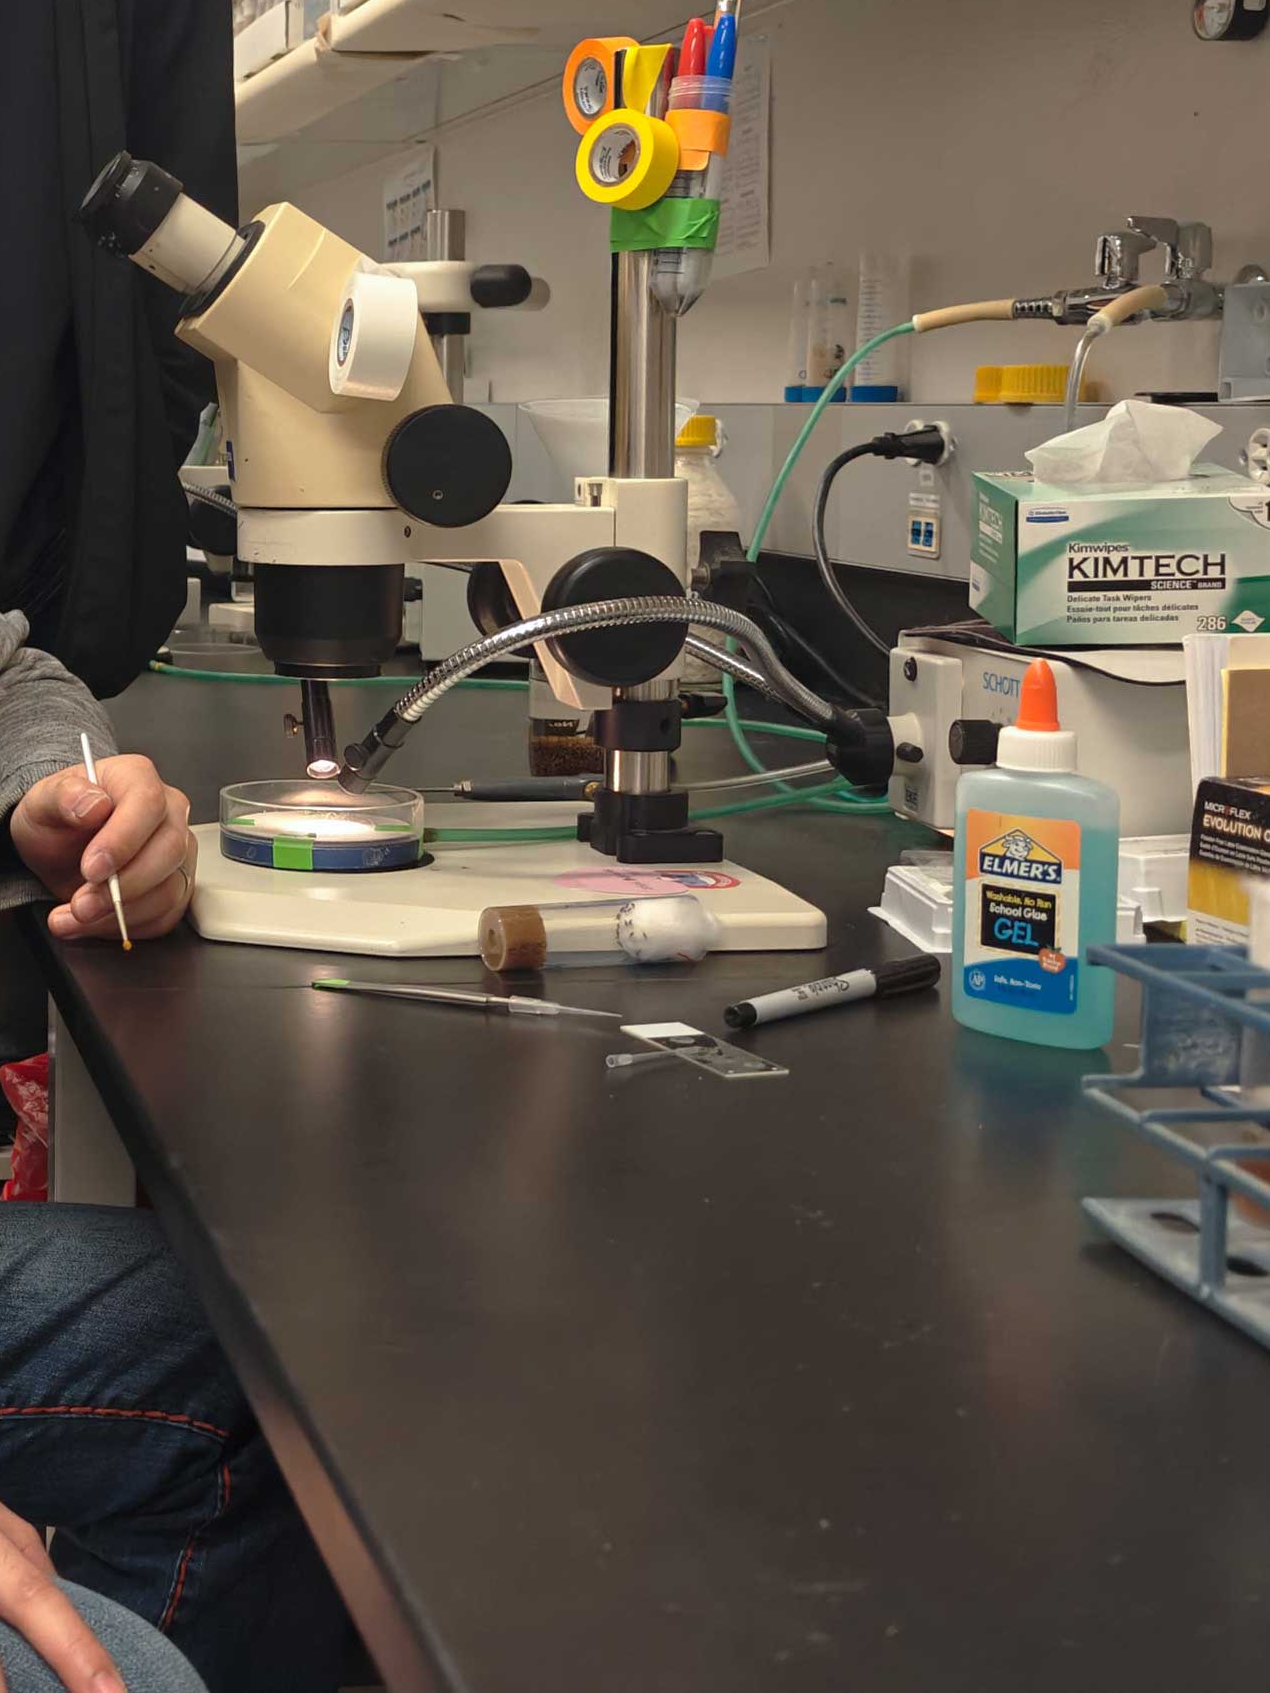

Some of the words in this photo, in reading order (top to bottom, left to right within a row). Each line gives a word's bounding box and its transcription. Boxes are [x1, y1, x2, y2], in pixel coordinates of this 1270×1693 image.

[1068, 542, 1129, 555] Kimwipes
[1068, 554, 1226, 579] KIMTECH
[1151, 580, 1192, 590] SCIENCE
[1067, 595, 1100, 603] Delicate
[1103, 594, 1120, 602] Task
[1122, 594, 1152, 603] Wipers
[1113, 606, 1131, 614] pour
[1093, 616, 1110, 624] para
[1196, 616, 1226, 631] 286
[983, 672, 1020, 698] SCHOTT
[1203, 813, 1262, 841] EVOLUTION
[982, 856, 1058, 881] ELMER'S
[1037, 898, 1052, 909] Run
[989, 902, 1022, 917] School
[1023, 907, 1048, 921] Glue
[994, 917, 1040, 946] GEL
